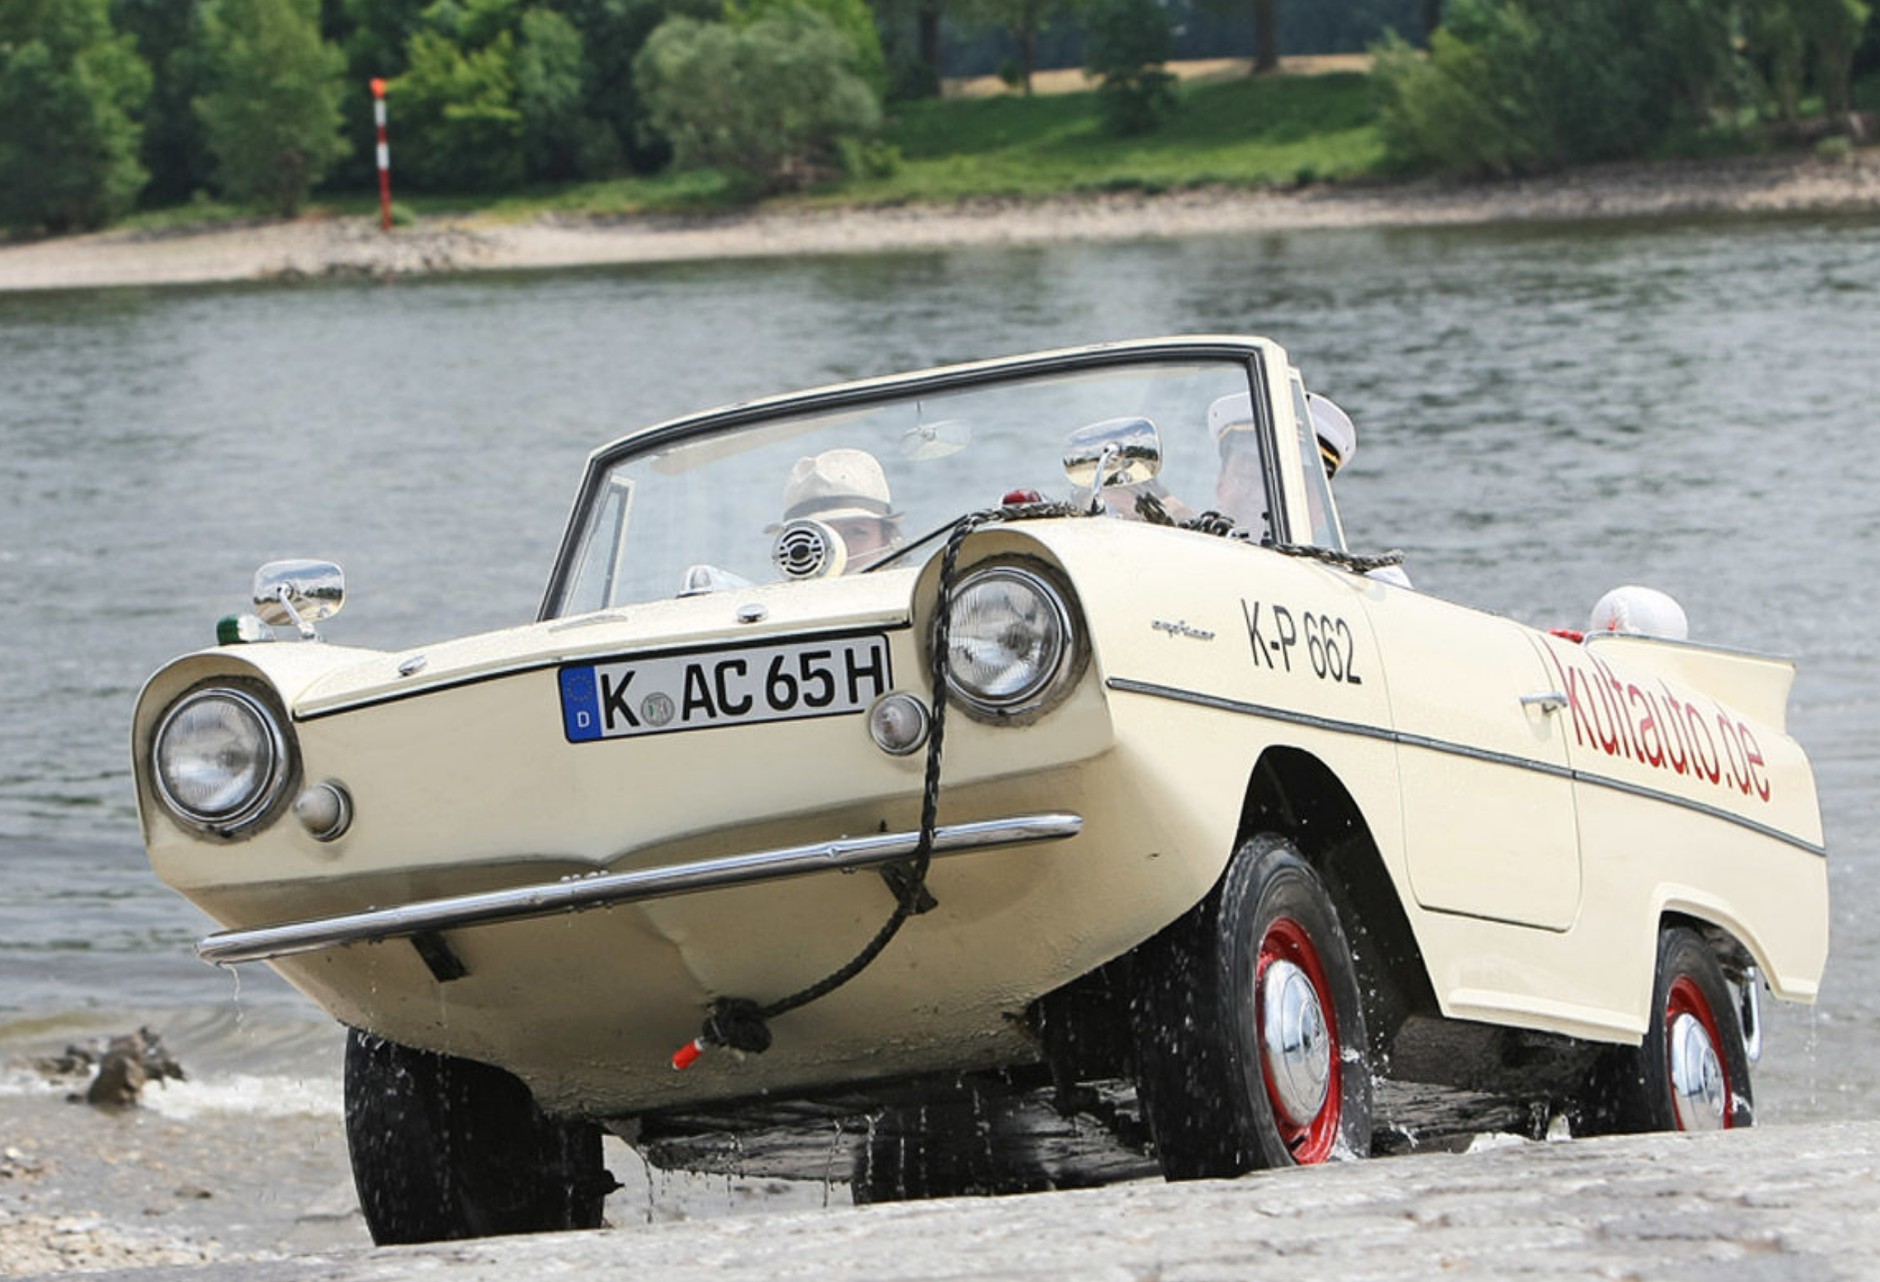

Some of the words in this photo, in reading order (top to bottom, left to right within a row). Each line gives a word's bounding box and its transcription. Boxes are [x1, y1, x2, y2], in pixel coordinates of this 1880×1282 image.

[1241, 598, 1296, 672] K-P
[1304, 611, 1362, 684] 662
[577, 712, 589, 728] D
[601, 671, 640, 730] K
[682, 659, 753, 721] AC
[1537, 634, 1770, 802] kultauto.de
